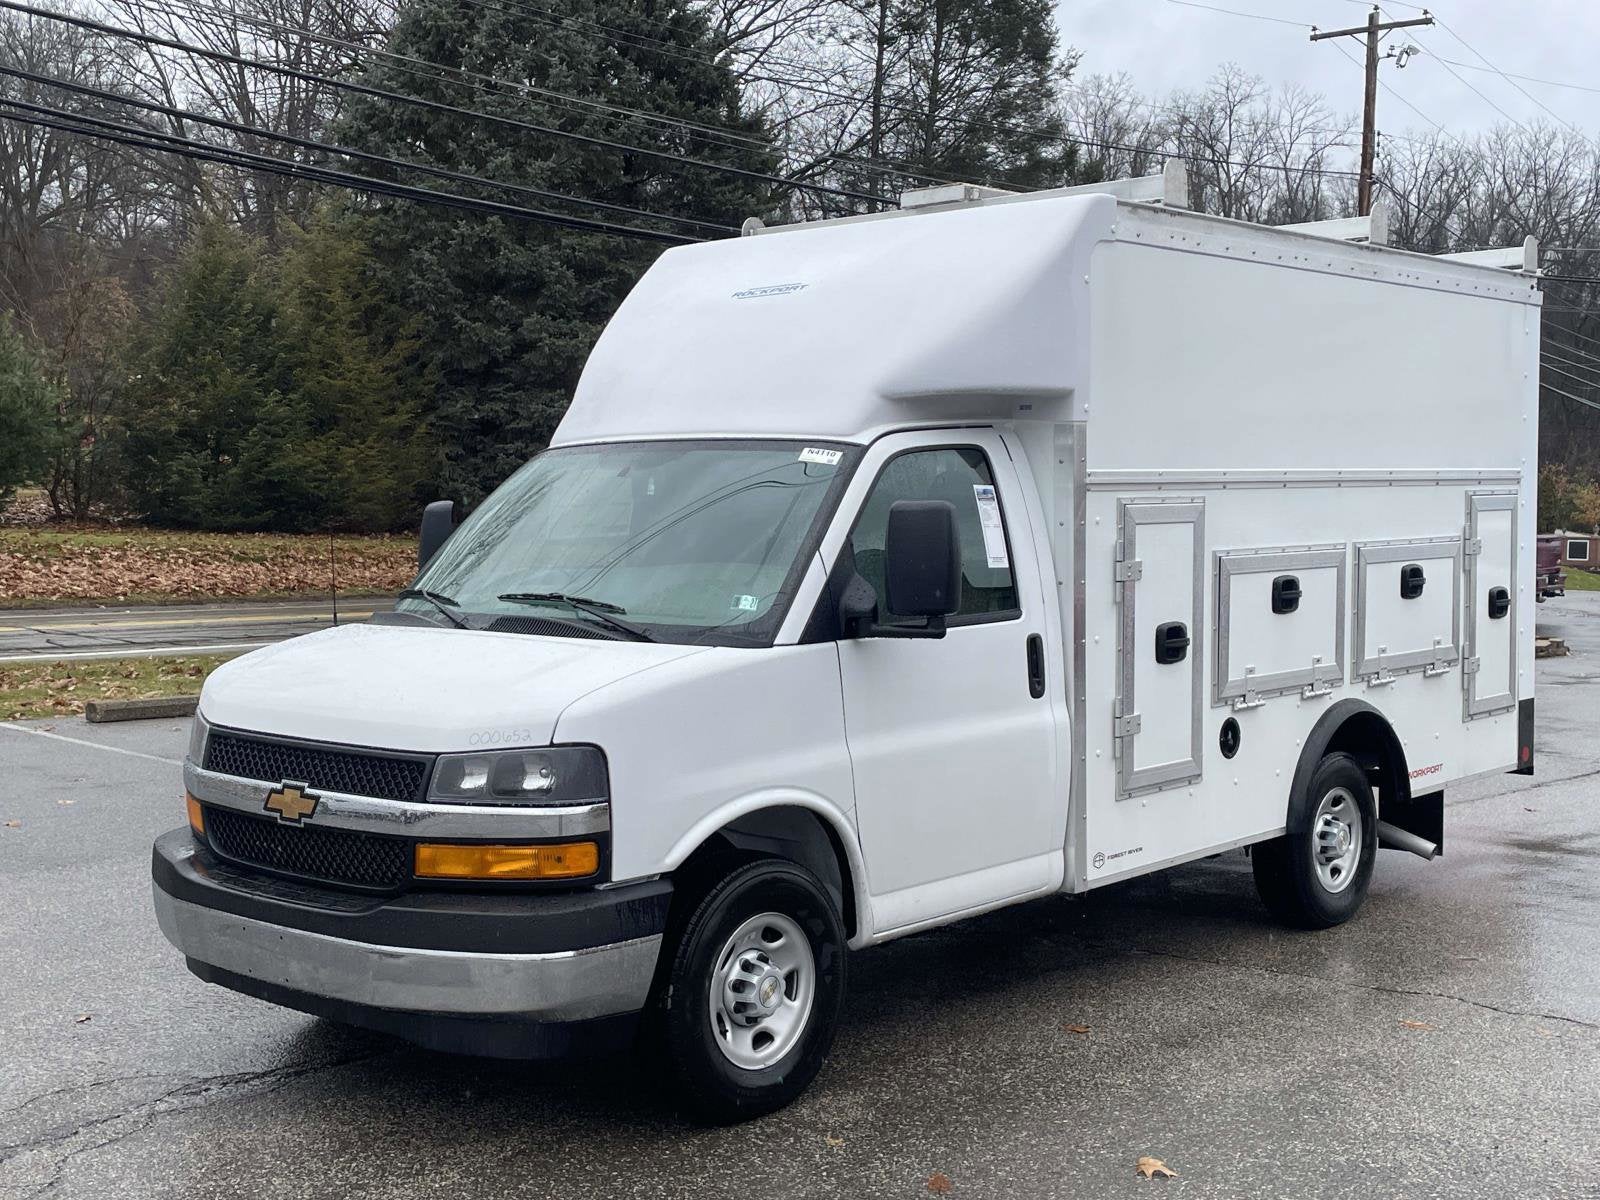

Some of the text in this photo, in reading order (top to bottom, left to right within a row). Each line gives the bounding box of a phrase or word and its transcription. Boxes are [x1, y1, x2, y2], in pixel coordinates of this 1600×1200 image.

[731, 284, 809, 297] ROCKPORT
[807, 449, 837, 457] N4110
[469, 729, 532, 745] 000652
[1107, 847, 1143, 860] FOREST RIVER
